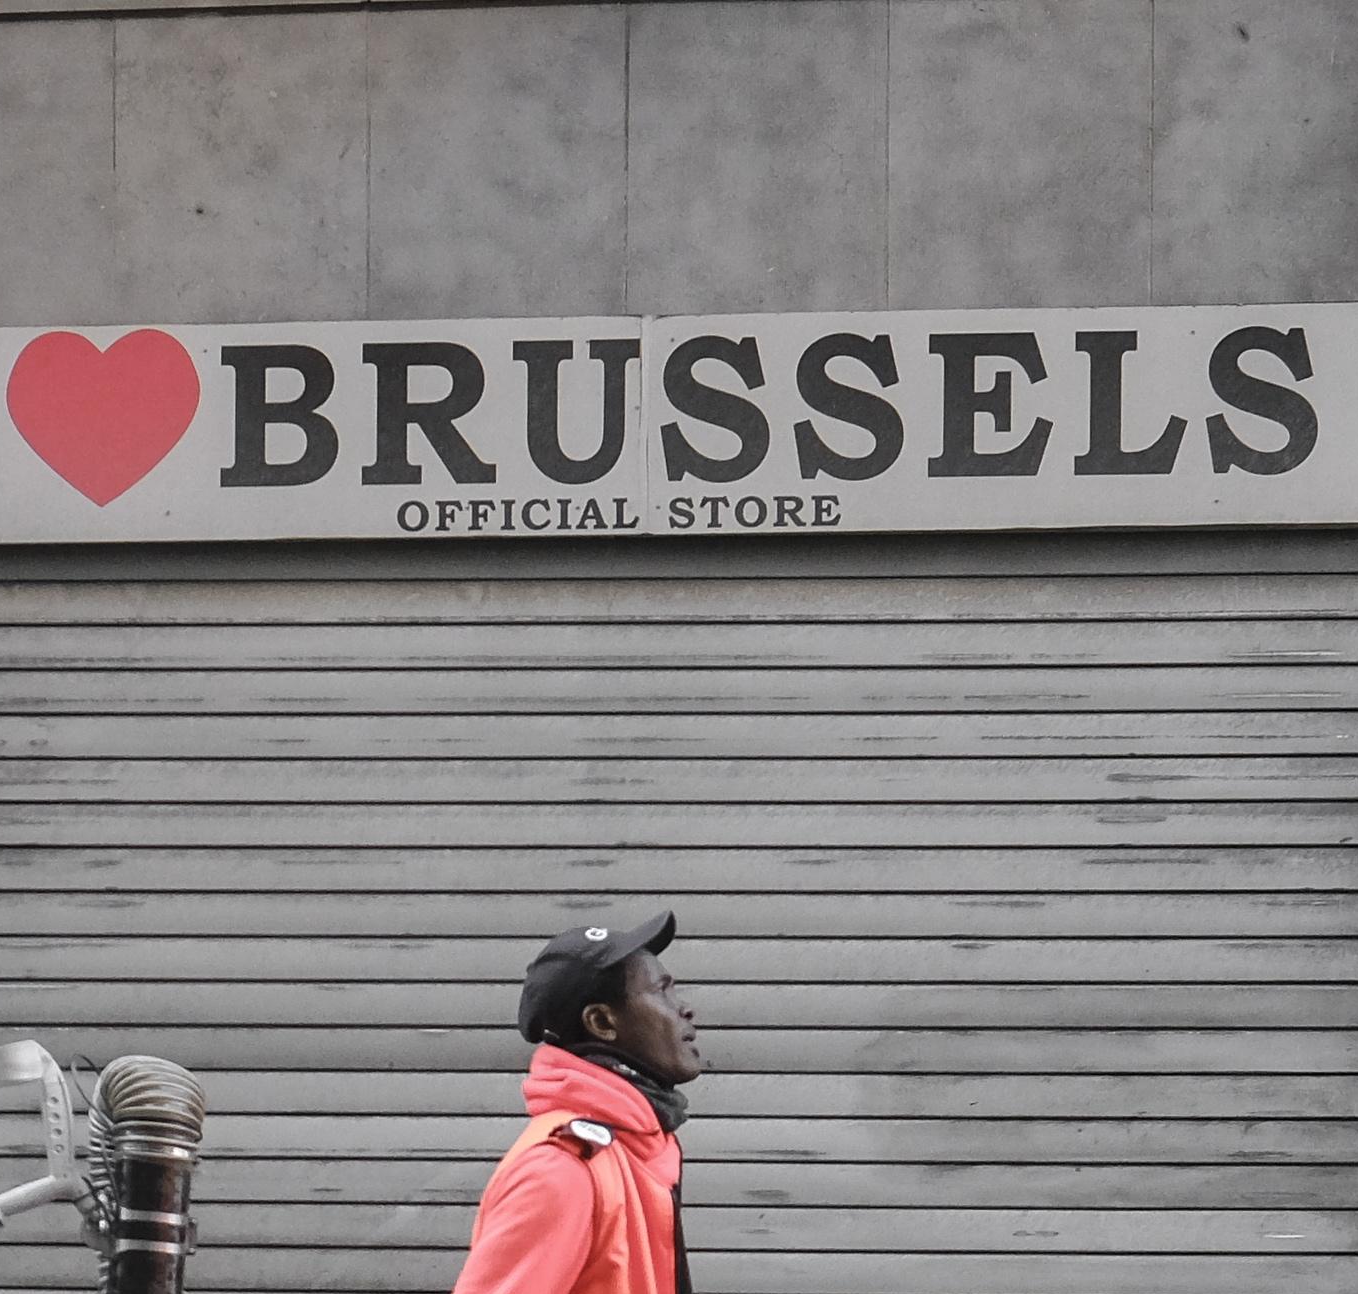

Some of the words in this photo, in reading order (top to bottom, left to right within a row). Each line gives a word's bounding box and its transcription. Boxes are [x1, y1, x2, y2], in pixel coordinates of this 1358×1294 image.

[220, 326, 1318, 487] BRUSSELS
[397, 498, 638, 533] OFFICIAL
[668, 496, 842, 529] STORE
